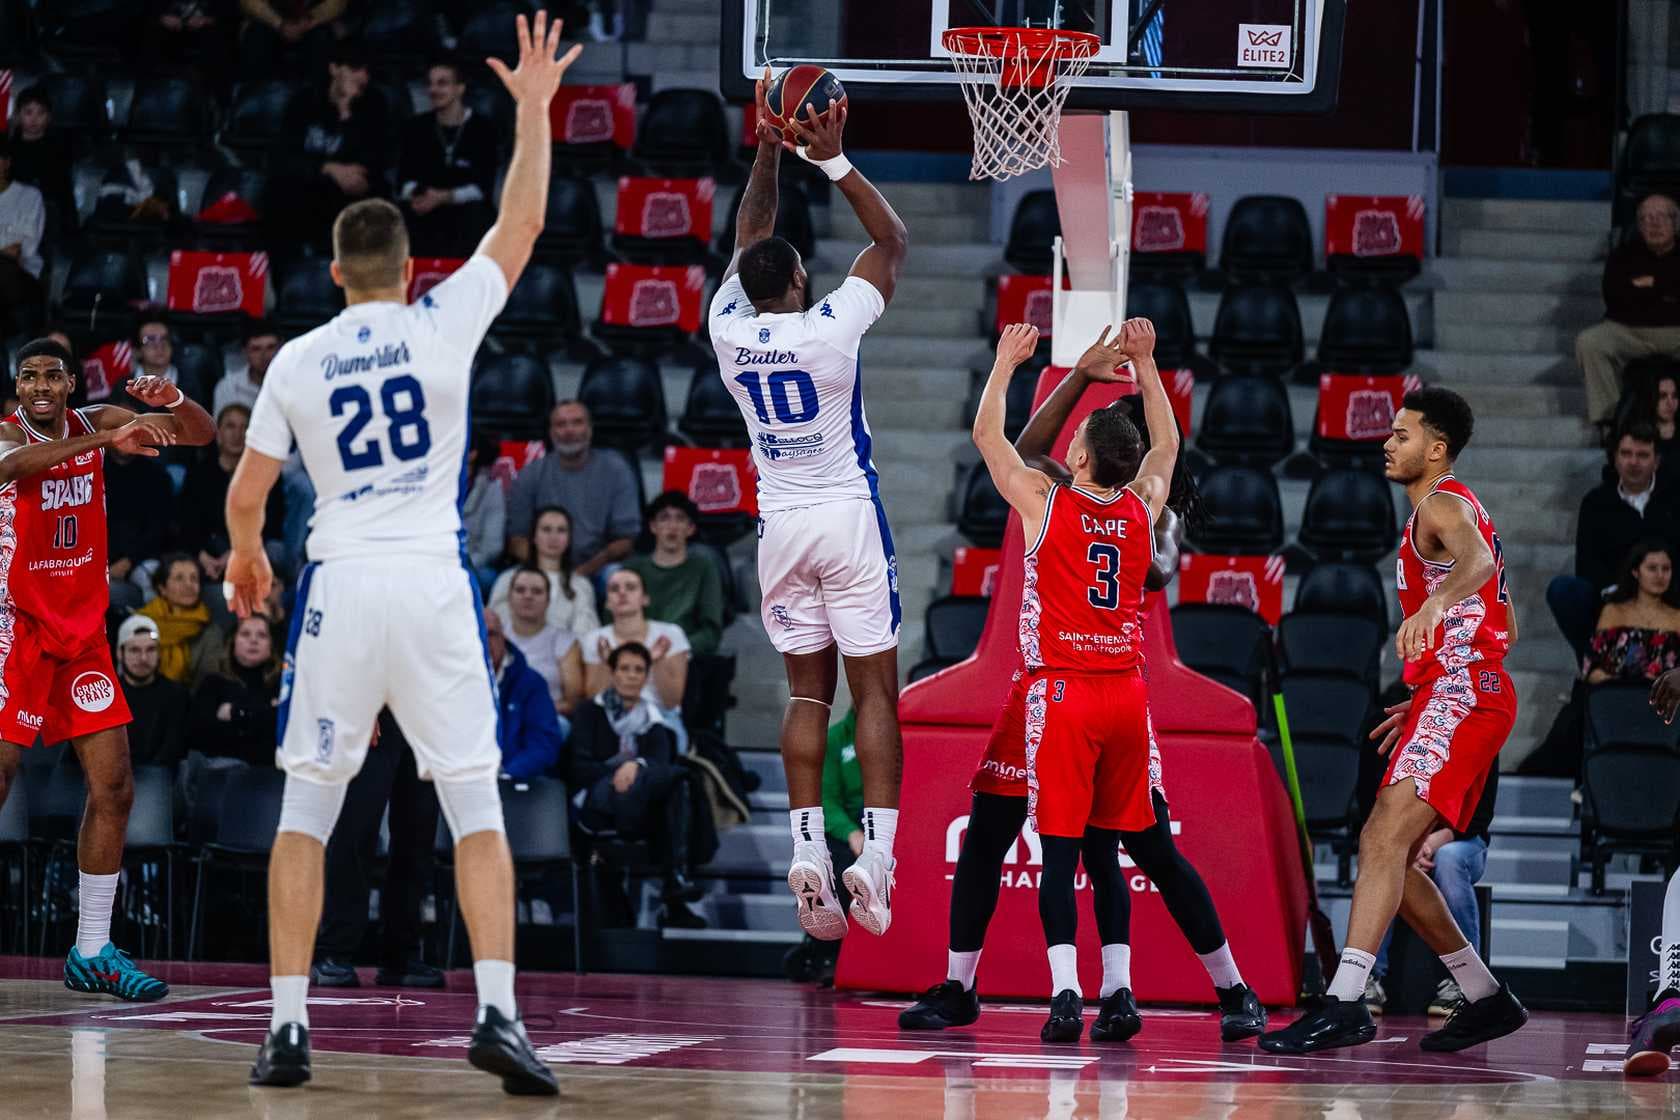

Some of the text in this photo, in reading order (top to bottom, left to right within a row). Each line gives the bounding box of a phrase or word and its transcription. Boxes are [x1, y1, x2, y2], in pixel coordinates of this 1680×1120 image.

[734, 347, 799, 366] Butler
[734, 370, 820, 425] 10
[329, 374, 432, 472] 28
[53, 514, 78, 550] 10
[1081, 514, 1128, 539] CAPE
[1087, 542, 1121, 610] 3
[305, 608, 323, 637] 28
[76, 679, 108, 696] GRAND
[1053, 680, 1065, 702] 3
[1480, 671, 1501, 693] 22
[79, 687, 111, 705] FRAIS
